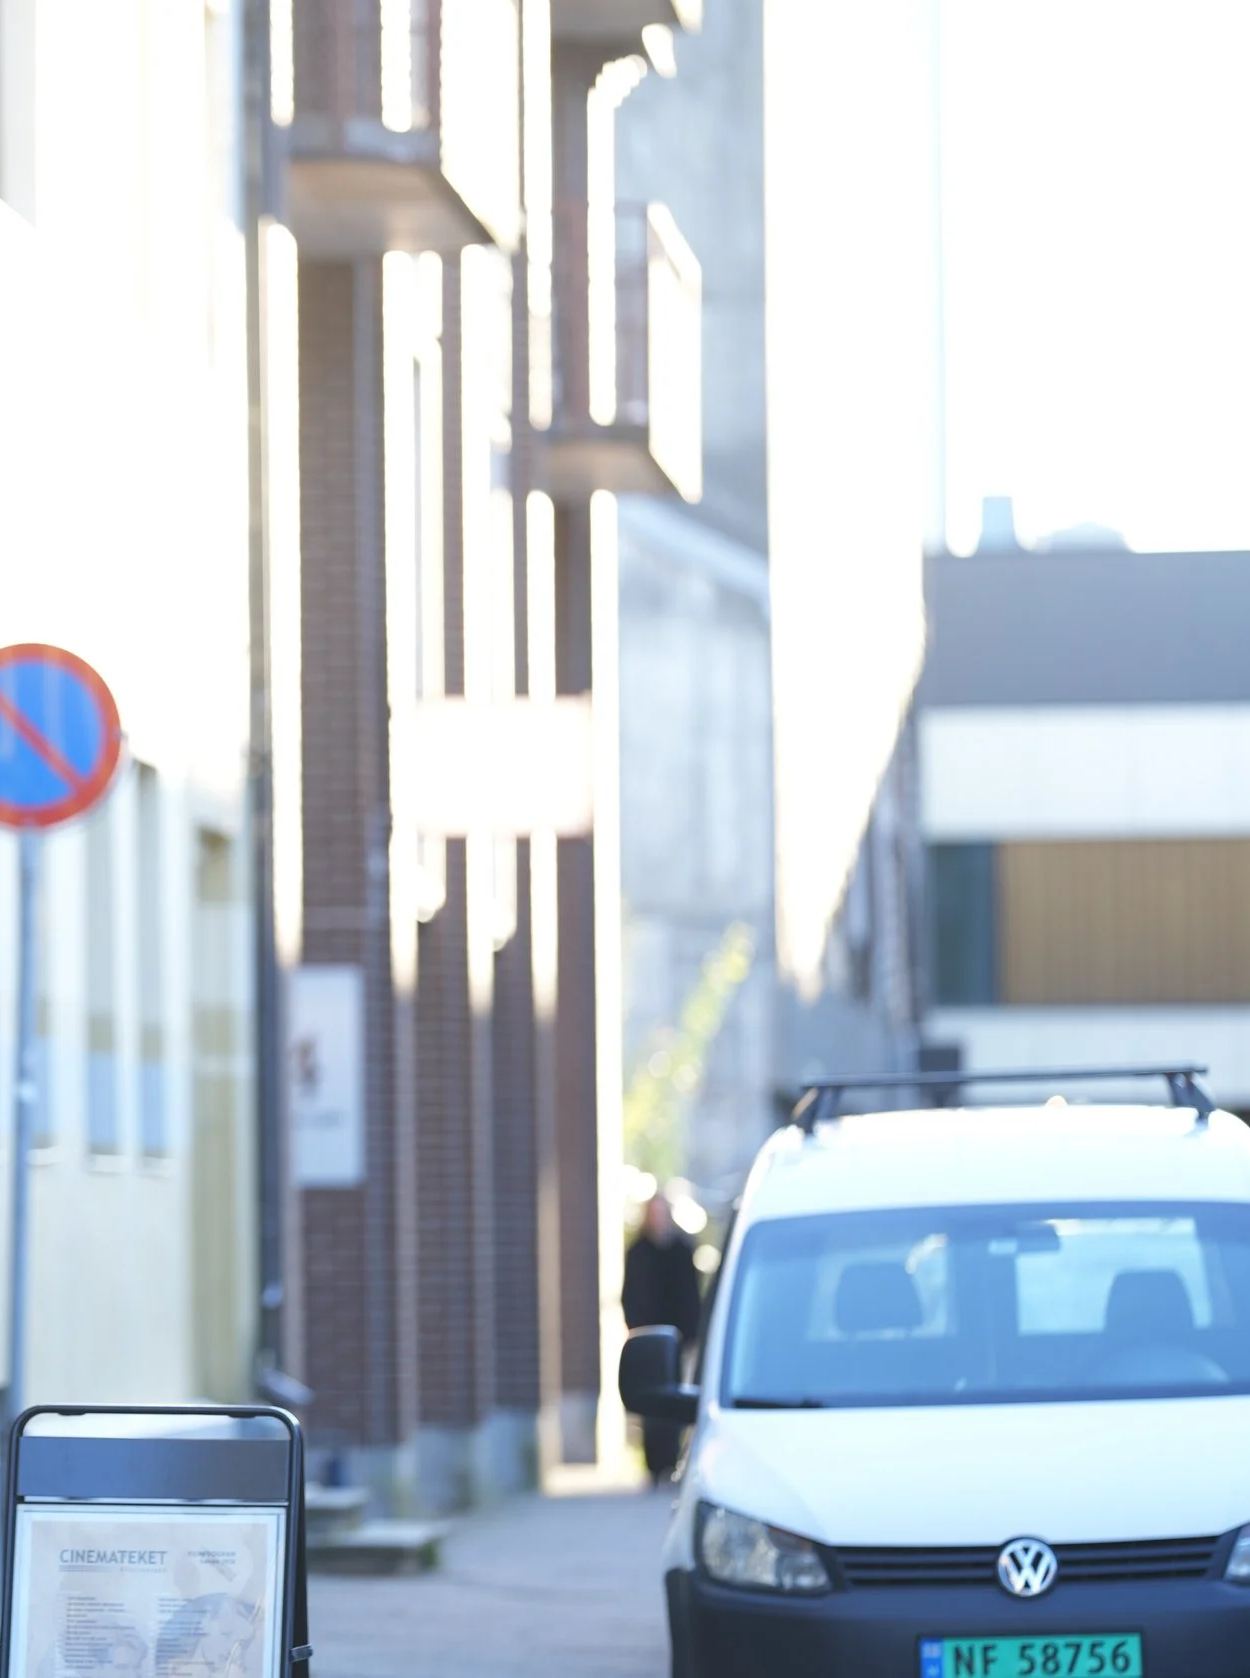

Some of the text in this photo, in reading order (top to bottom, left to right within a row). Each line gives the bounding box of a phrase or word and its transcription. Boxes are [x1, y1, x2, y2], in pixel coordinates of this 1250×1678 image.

[59, 1549, 168, 1565] CINEMATEKET
[953, 1641, 1131, 1677] NF 58756
